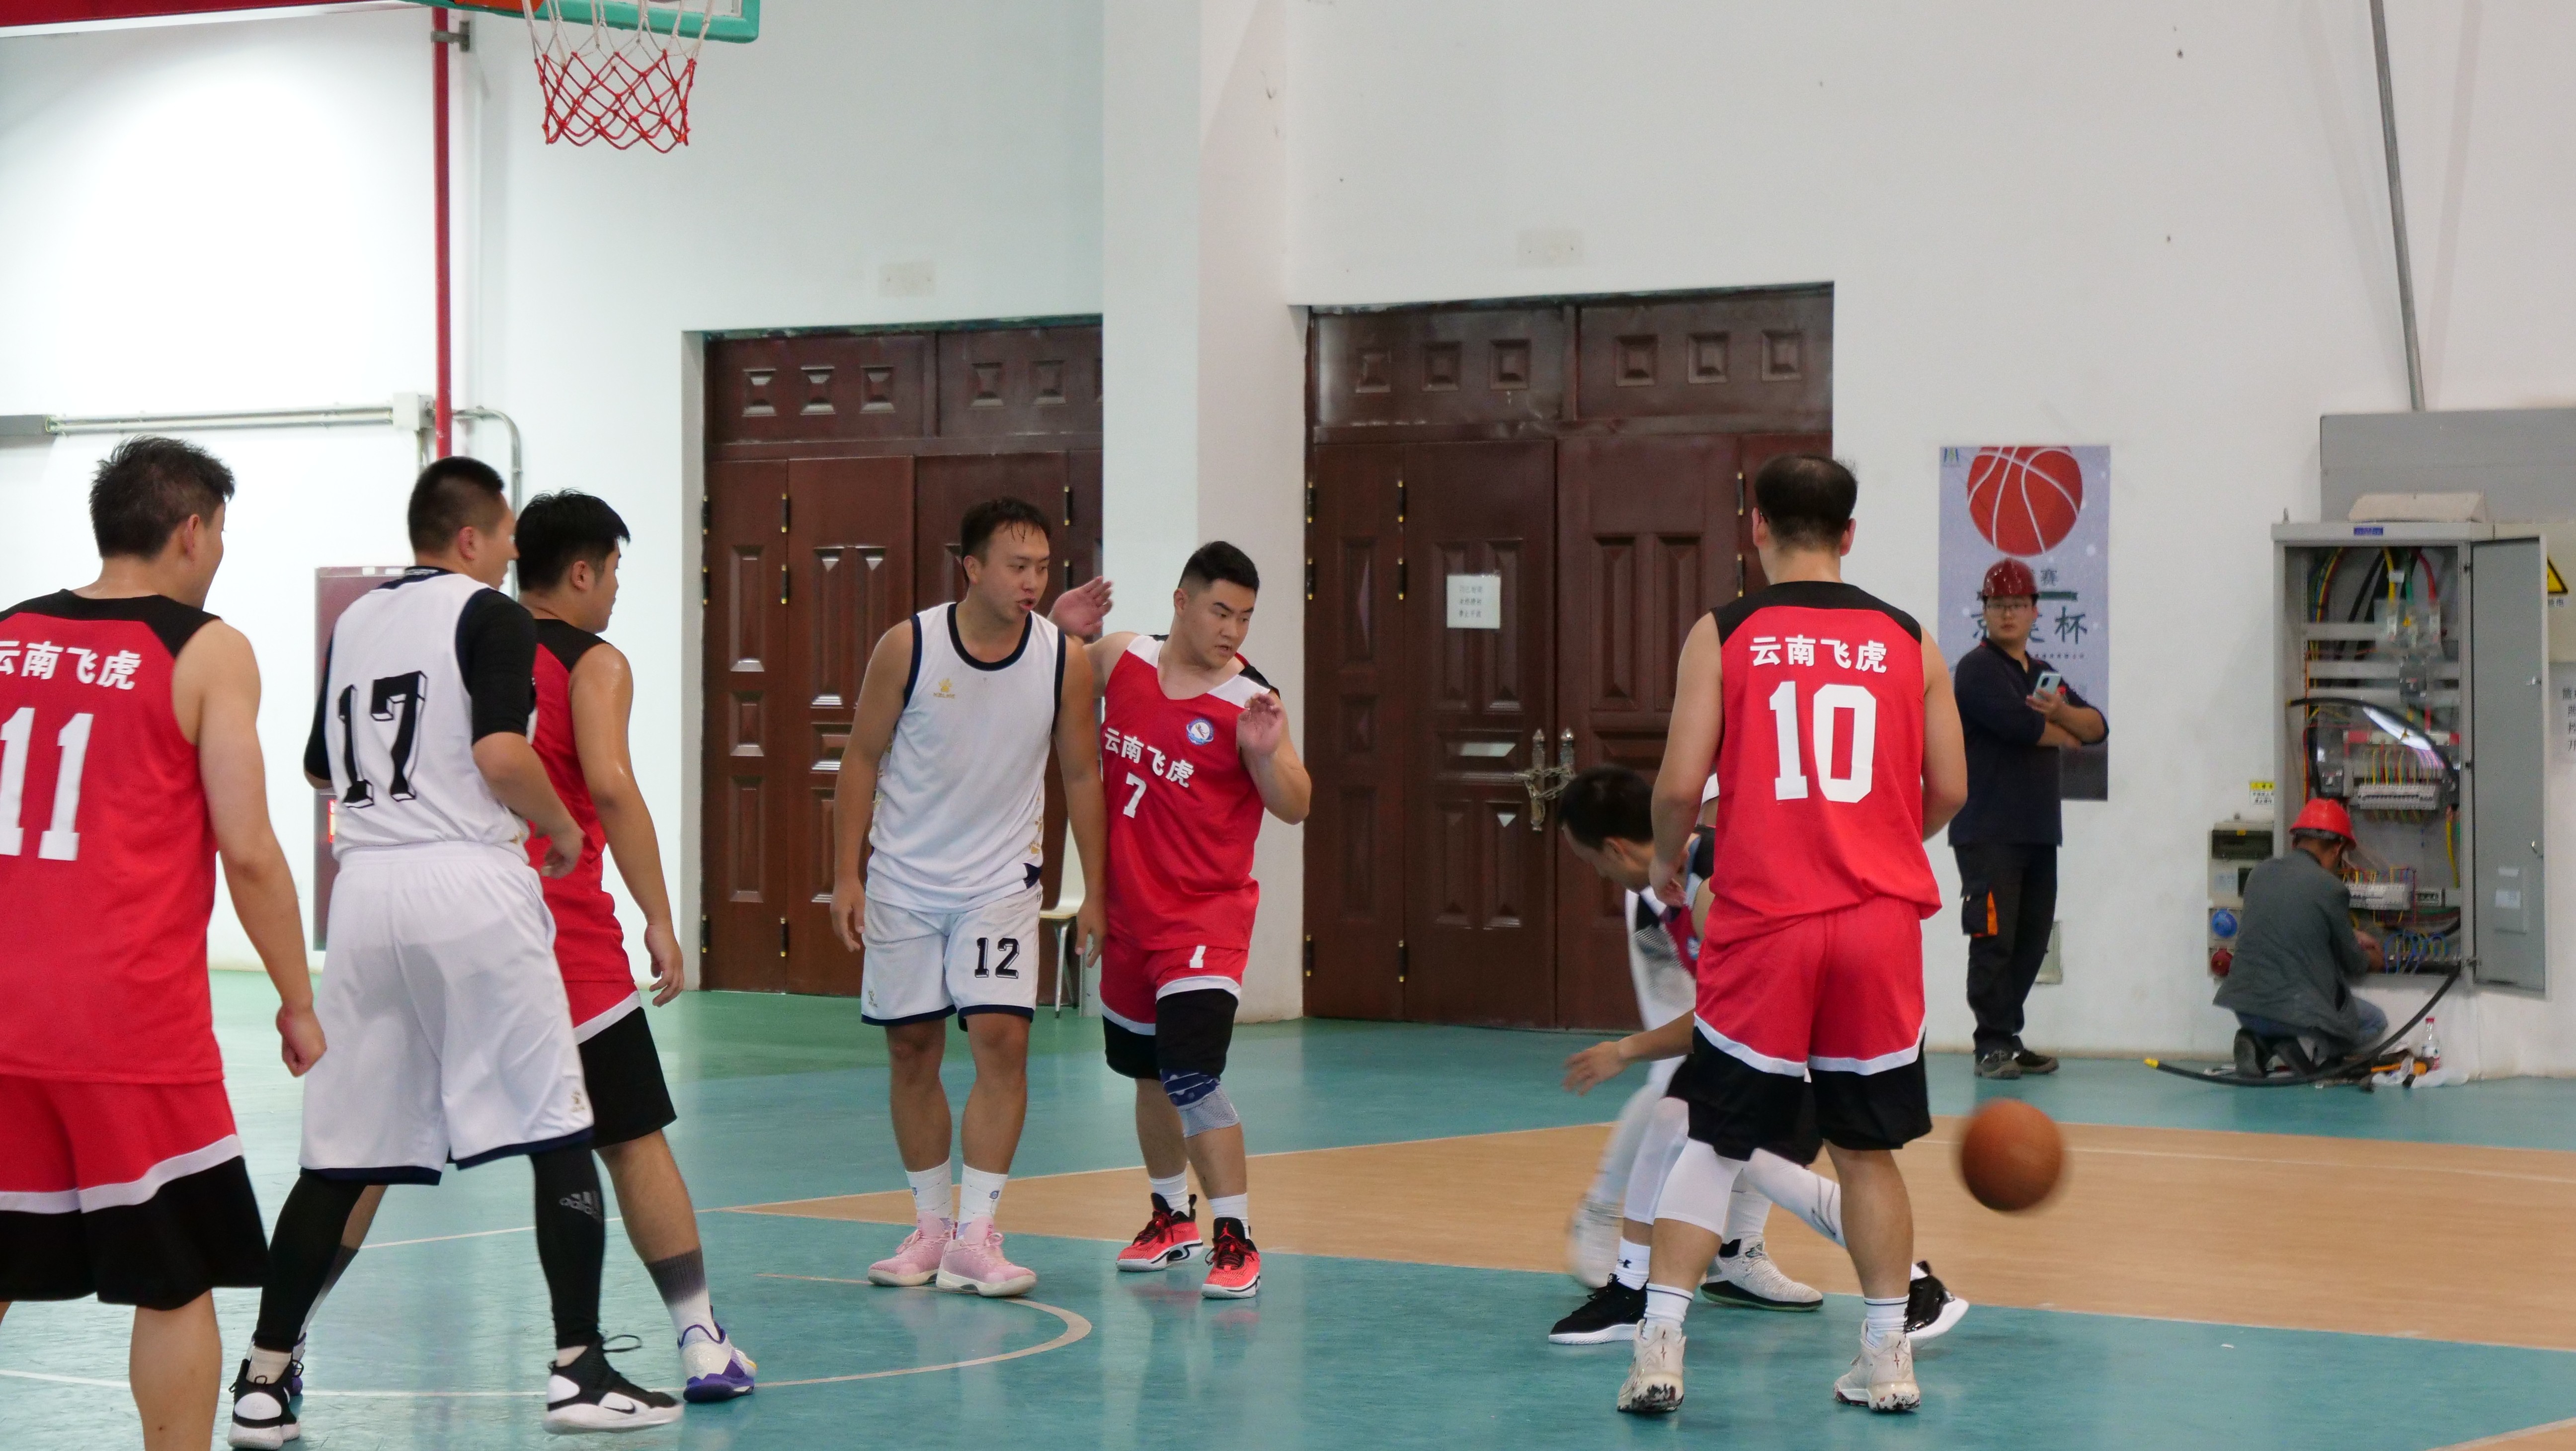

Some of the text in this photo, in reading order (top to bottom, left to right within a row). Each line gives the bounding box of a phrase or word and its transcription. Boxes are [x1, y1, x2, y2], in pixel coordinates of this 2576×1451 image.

[0, 641, 142, 690] 云南飞虎
[1750, 634, 1887, 673] 云南飞虎
[338, 670, 428, 808] 17
[1105, 727, 1195, 788] 云南飞虎
[1769, 681, 1877, 803] 10
[0, 707, 94, 861] 11
[1123, 772, 1147, 819] 7
[974, 937, 1020, 979] 12
